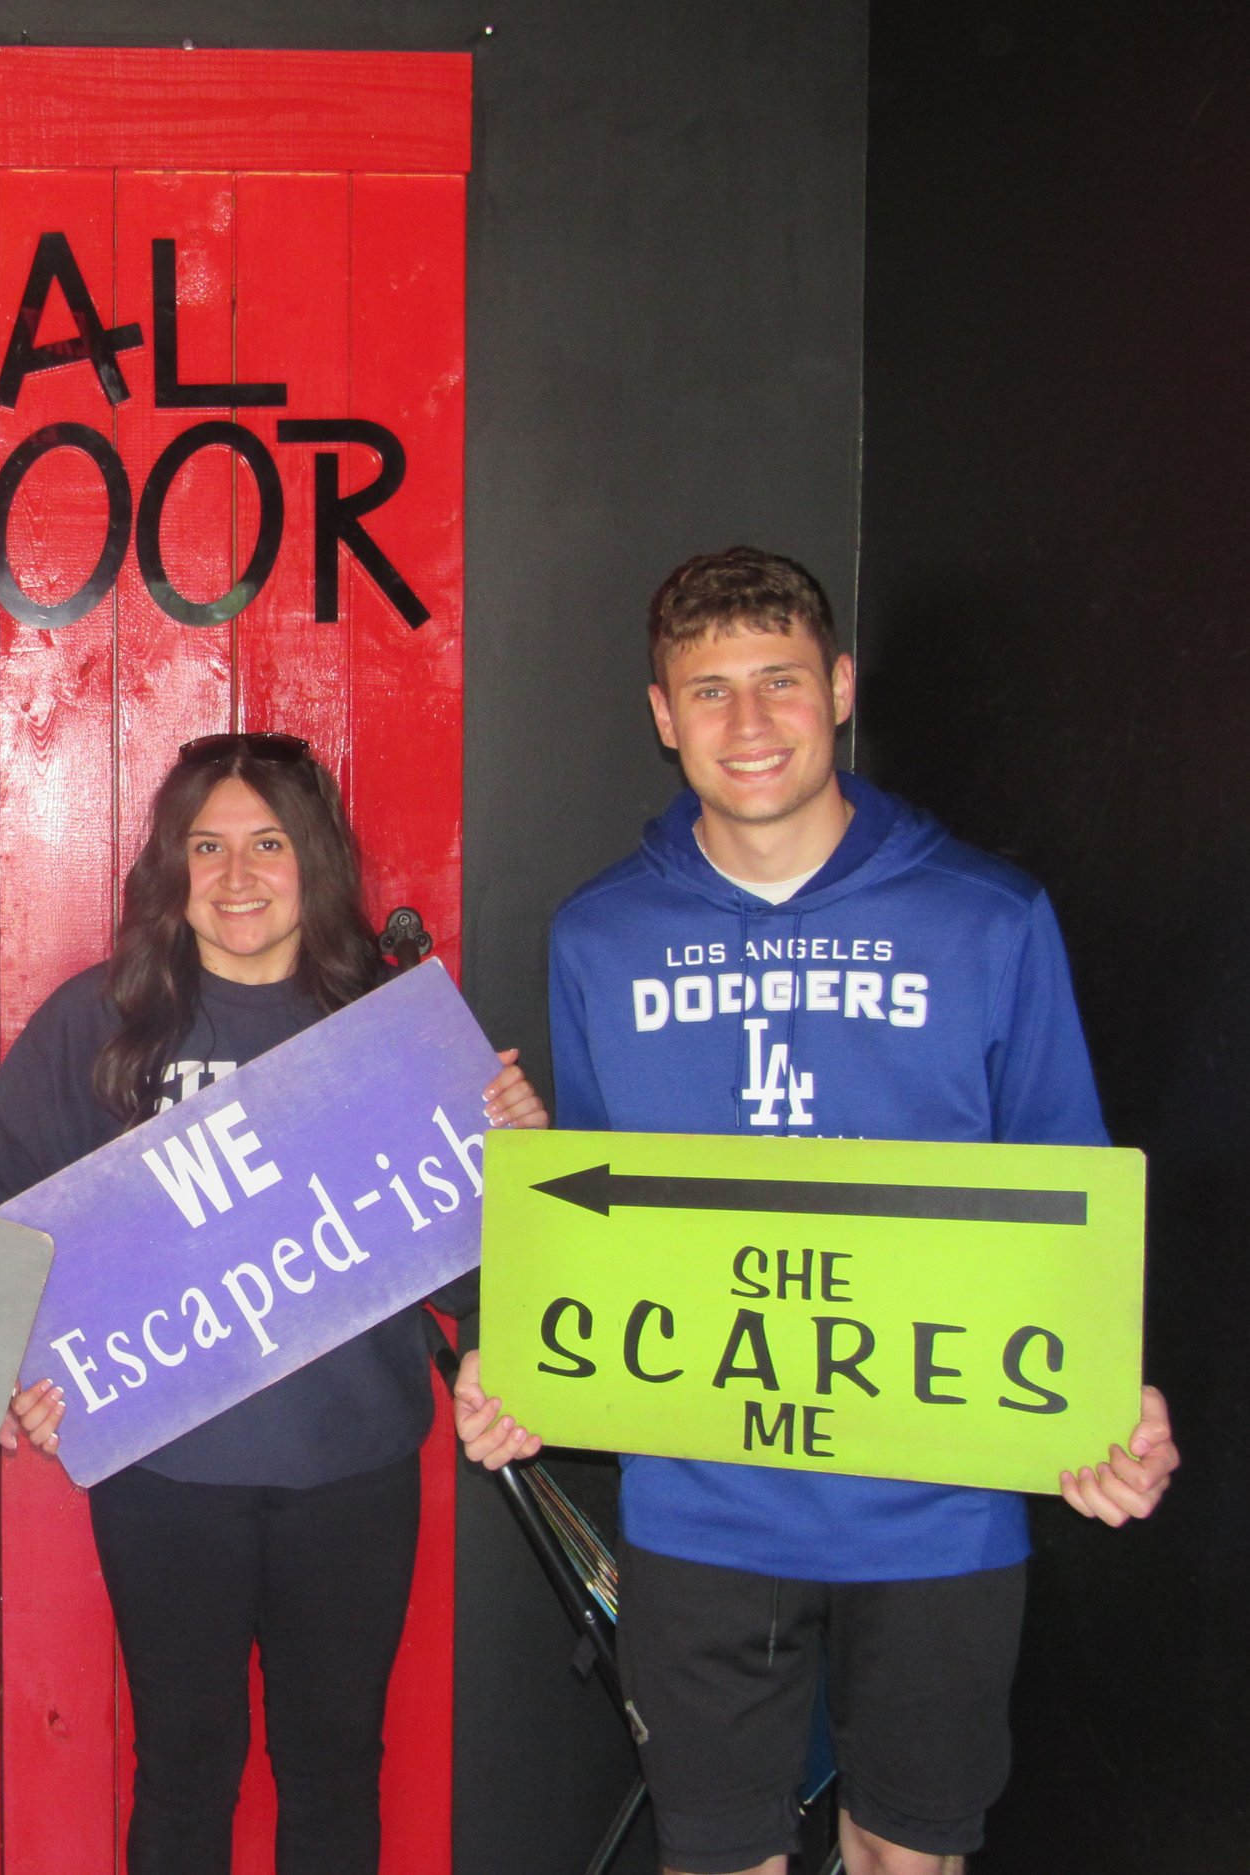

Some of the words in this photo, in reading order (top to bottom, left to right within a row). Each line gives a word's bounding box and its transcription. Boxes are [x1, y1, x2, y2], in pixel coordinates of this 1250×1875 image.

[666, 943, 726, 967] LOS
[741, 938, 893, 962] ANGELES
[632, 970, 929, 1032] DODGERS
[741, 1018, 814, 1126] LA
[142, 1100, 283, 1229] WE
[50, 1105, 484, 1415] Escaped-ish
[730, 1245, 854, 1302] SHE
[537, 1296, 1069, 1414] SCARES
[743, 1400, 836, 1457] ME
